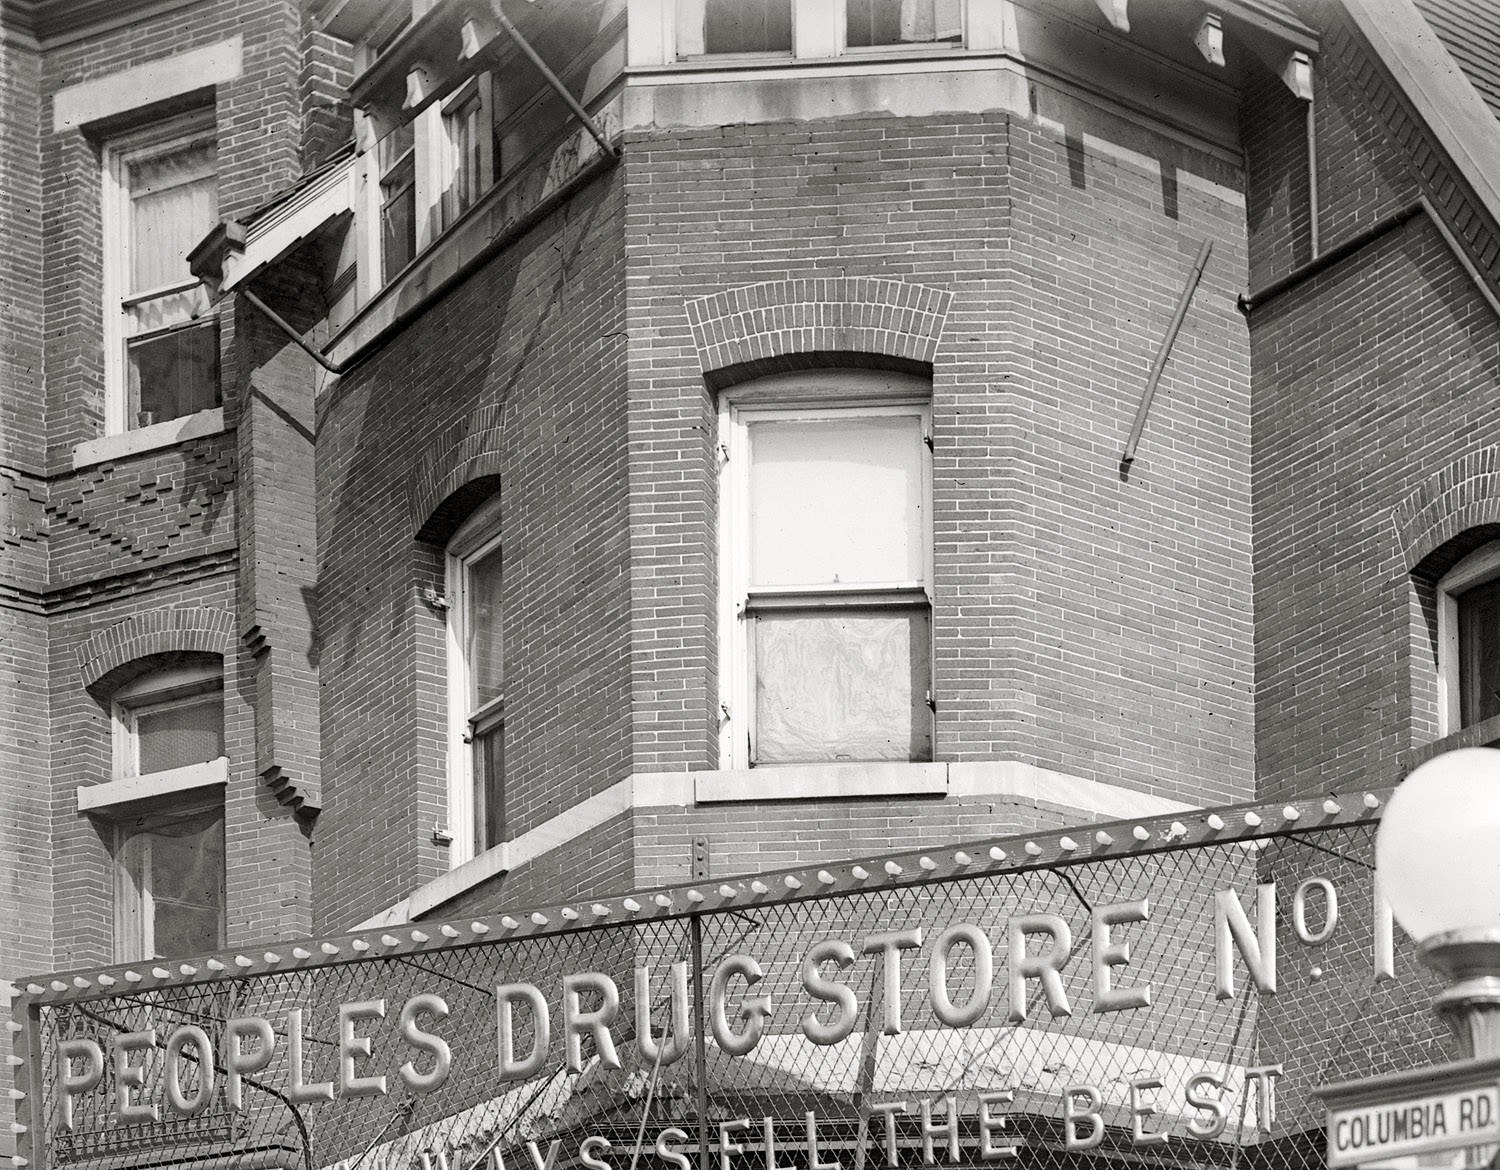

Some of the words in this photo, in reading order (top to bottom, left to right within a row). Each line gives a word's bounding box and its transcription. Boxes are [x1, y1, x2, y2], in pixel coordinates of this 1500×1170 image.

[55, 992, 452, 1132] PEOPLES
[496, 953, 773, 1082] DRUG
[800, 898, 1152, 1046] STORE
[869, 1090, 1018, 1168] THE
[1063, 1063, 1285, 1152] BEST
[1335, 1102, 1448, 1152] COLUMBIA
